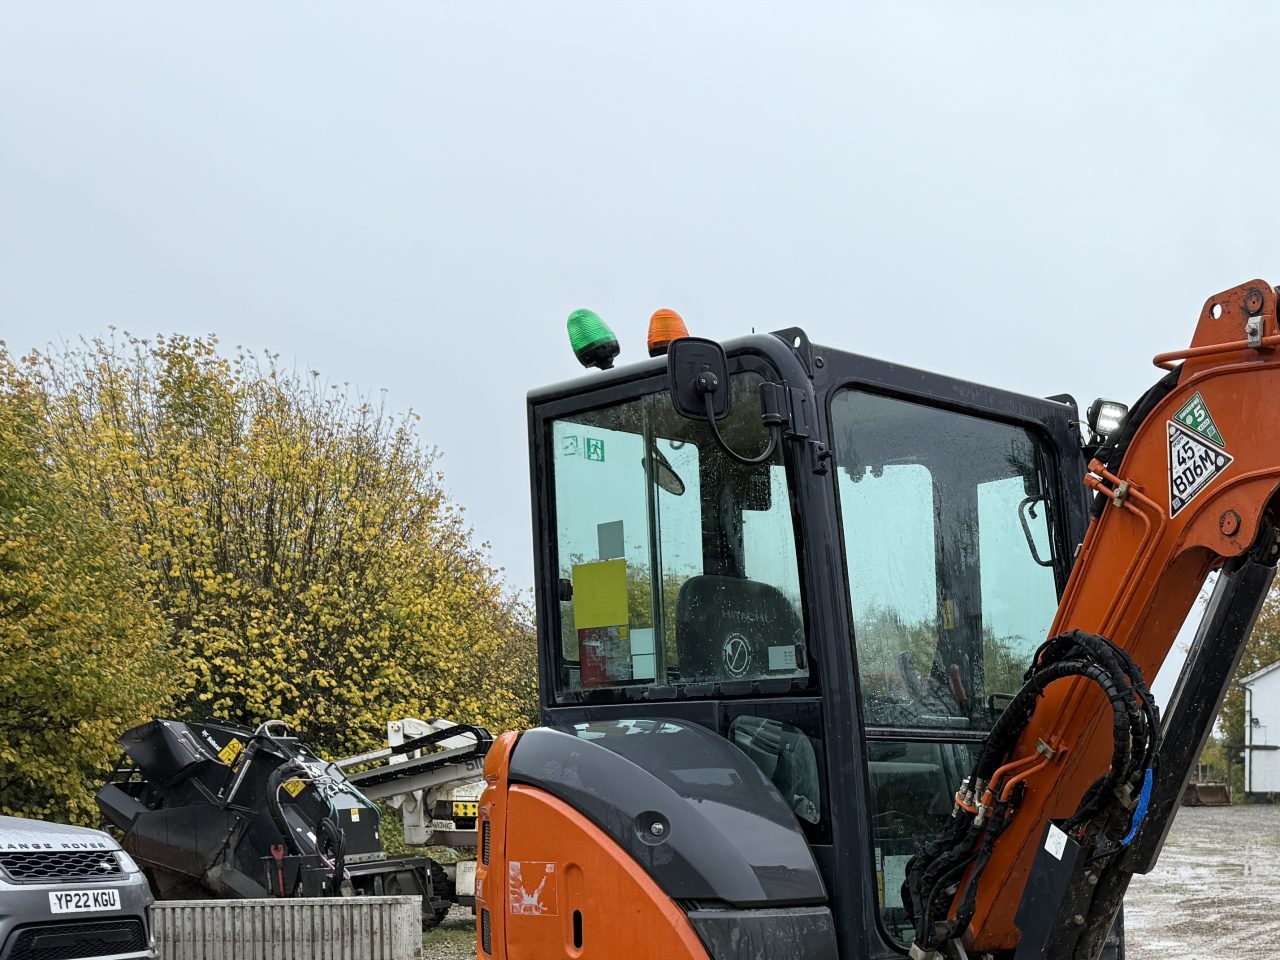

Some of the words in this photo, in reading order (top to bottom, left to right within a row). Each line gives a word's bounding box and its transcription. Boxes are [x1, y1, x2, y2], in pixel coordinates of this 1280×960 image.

[1193, 405, 1206, 422] 5
[1176, 440, 1196, 467] 45
[60, 842, 107, 850] ROVER
[54, 892, 91, 910] YP22
[92, 891, 117, 909] KGU
